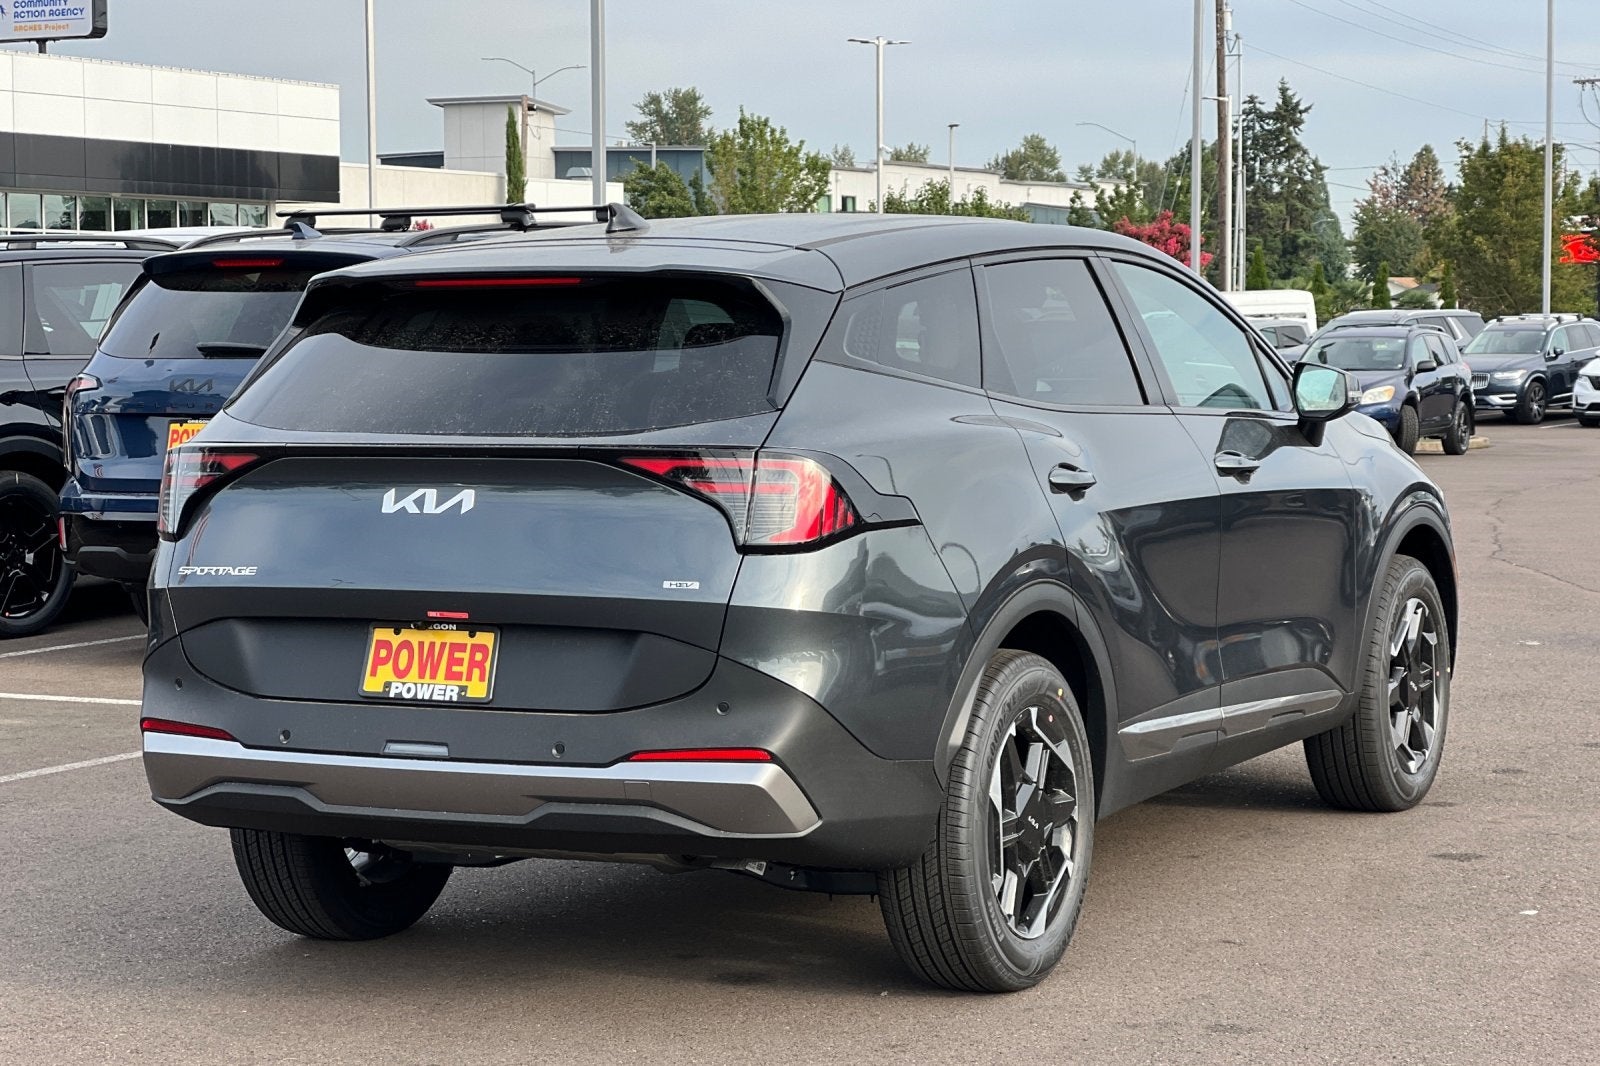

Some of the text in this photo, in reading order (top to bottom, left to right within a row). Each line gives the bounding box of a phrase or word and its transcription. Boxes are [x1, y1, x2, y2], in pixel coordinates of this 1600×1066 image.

[13, 0, 68, 8] COMMUNITY
[13, 7, 85, 19] ACTION AGENCY
[13, 23, 70, 32] ARCHES Project
[169, 378, 214, 392] KIA
[381, 487, 475, 514] KIA
[178, 566, 257, 576] SPORTAGE
[411, 623, 457, 631] GON
[369, 638, 490, 683] POWER
[389, 681, 459, 701] POWER
